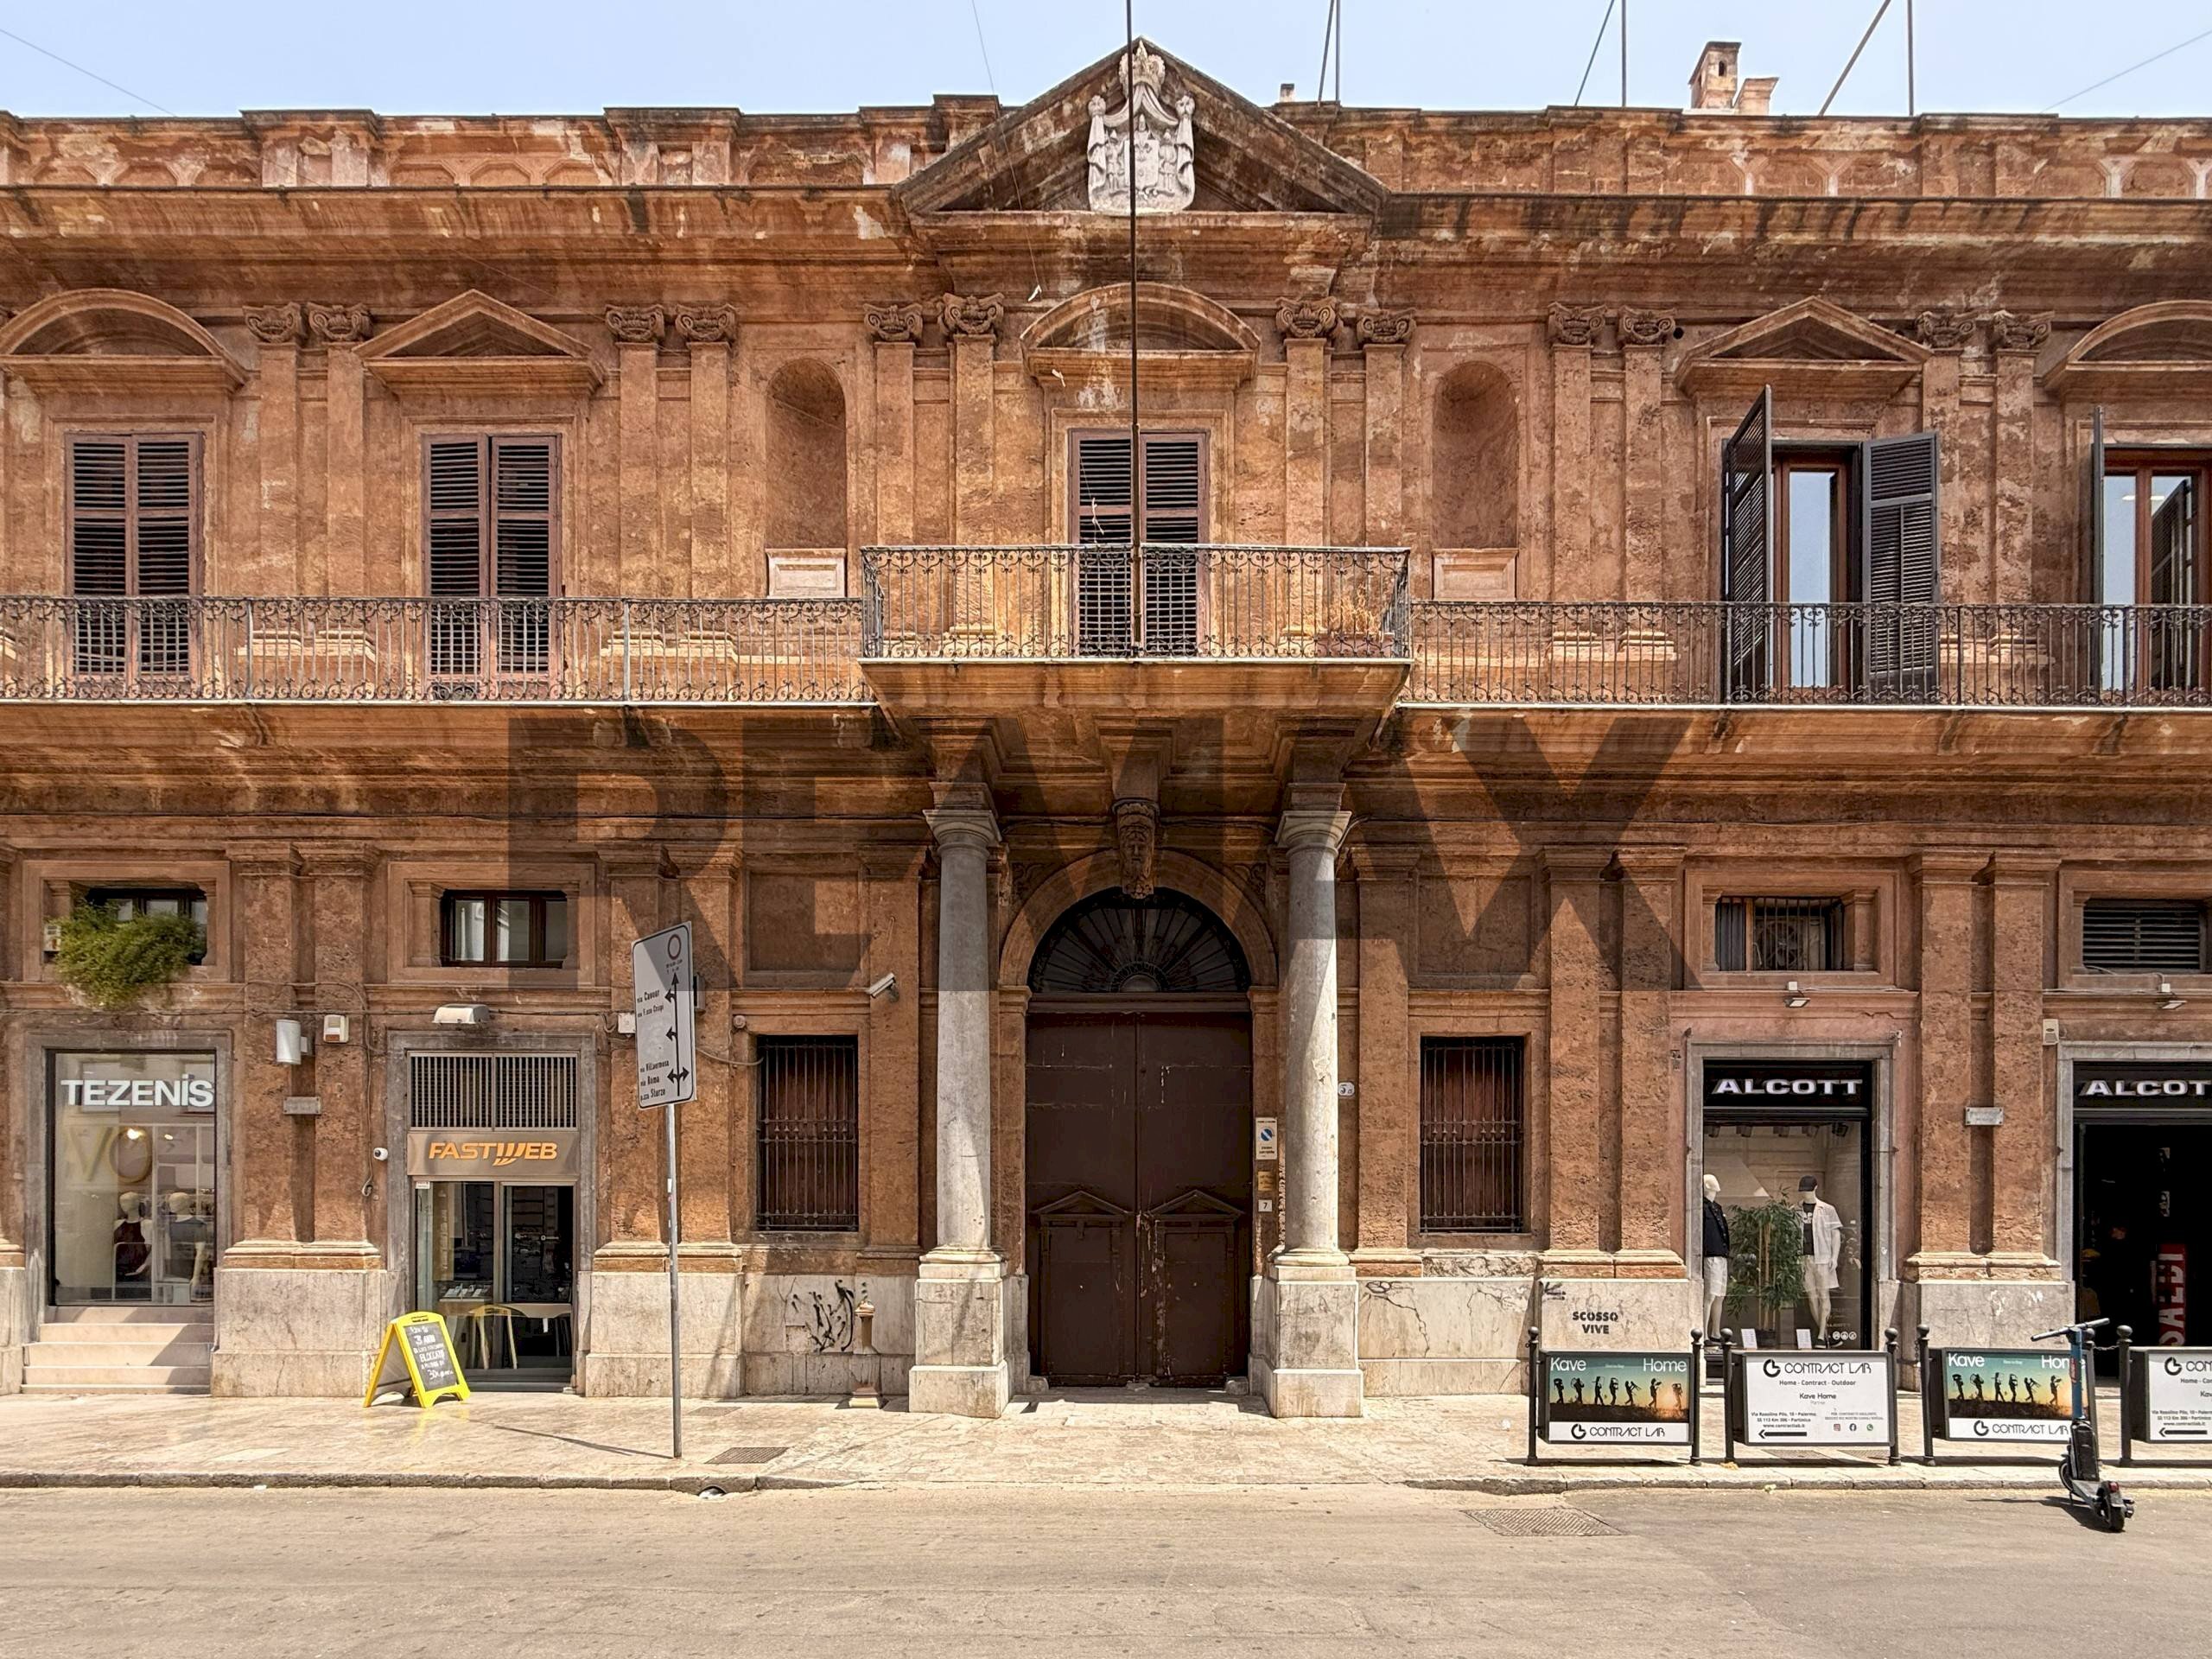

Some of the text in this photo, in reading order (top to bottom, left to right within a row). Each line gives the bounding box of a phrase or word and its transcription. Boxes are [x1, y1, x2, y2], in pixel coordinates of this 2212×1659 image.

[645, 989, 660, 1001] Cavour
[647, 1076, 659, 1085] Roma
[1712, 1078, 1863, 1095] ALCOTT
[2079, 1079, 2212, 1096] ALCOT
[429, 1141, 558, 1166] FASTWEB
[1572, 1311, 1619, 1323] SCOSSO
[1581, 1324, 1610, 1335] VIVE
[1550, 1357, 1586, 1372] Kave
[1643, 1358, 1688, 1373] Home
[1948, 1353, 1986, 1368] Kave
[1784, 1362, 1845, 1374] CONTRACT
[1589, 1427, 1642, 1438] CONTRACT
[1992, 1423, 2045, 1434] CONTRACT
